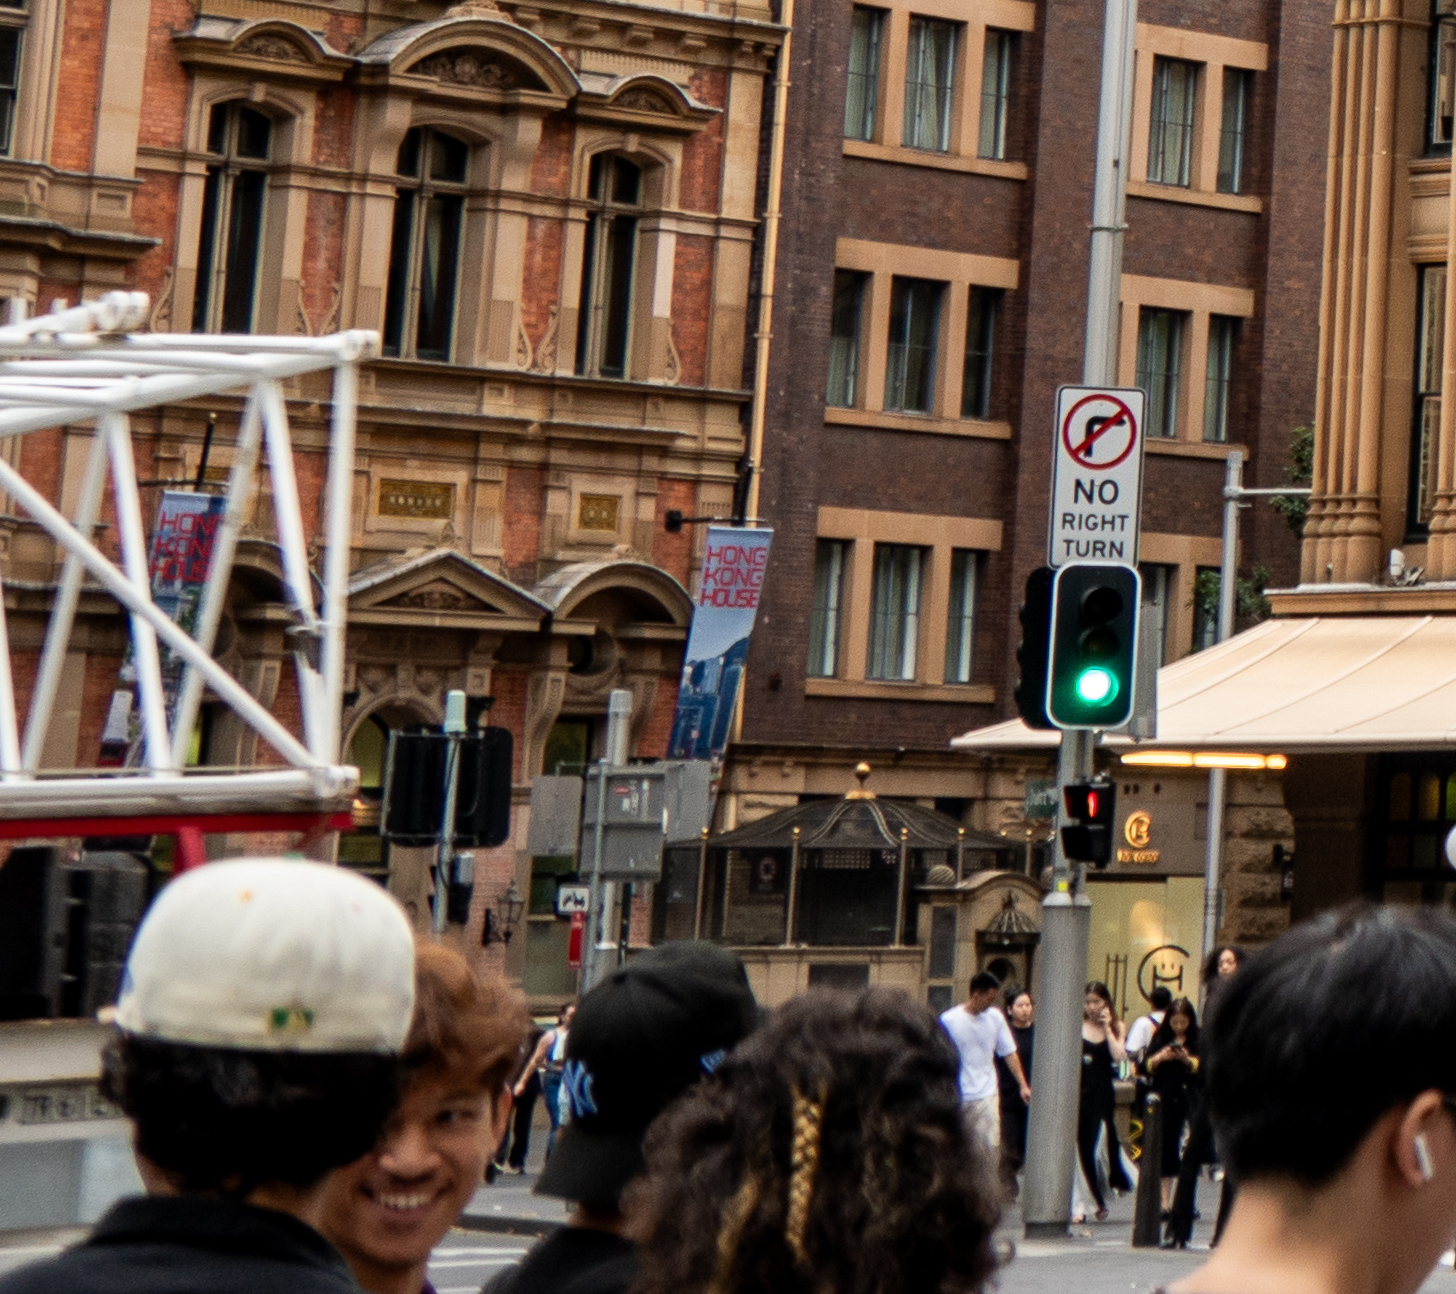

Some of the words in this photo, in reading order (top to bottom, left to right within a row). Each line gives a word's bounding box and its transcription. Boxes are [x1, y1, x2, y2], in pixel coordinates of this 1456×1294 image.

[1073, 478, 1119, 505] NO
[1061, 512, 1129, 532] RIGHT
[154, 535, 213, 559] KON
[706, 545, 767, 566] HONG
[1063, 539, 1124, 558] TURN
[703, 567, 764, 587] KONG
[700, 588, 758, 609] HOUSE
